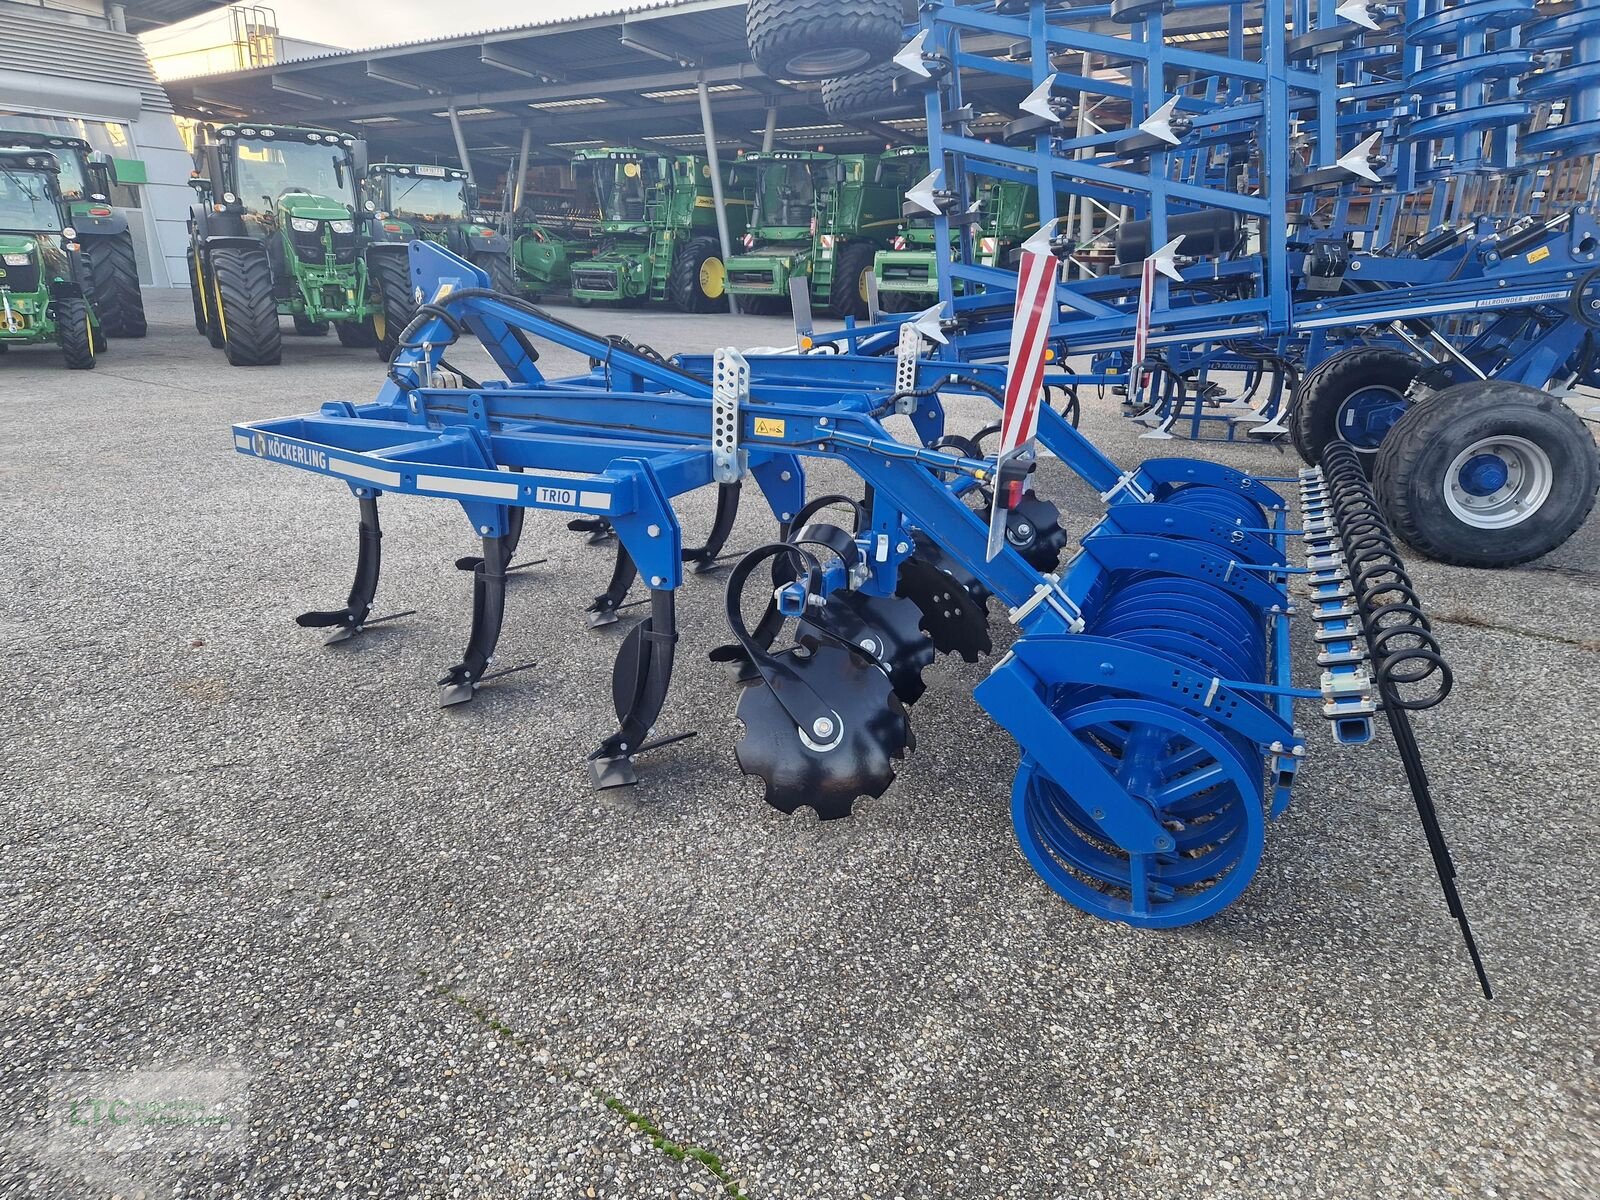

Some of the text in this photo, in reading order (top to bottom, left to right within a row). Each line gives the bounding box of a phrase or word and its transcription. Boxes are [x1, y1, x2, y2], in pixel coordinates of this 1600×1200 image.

[1481, 296, 1522, 305] ALLROUNDER
[268, 436, 326, 470] KÖCKERLING
[542, 489, 570, 503] TRIO
